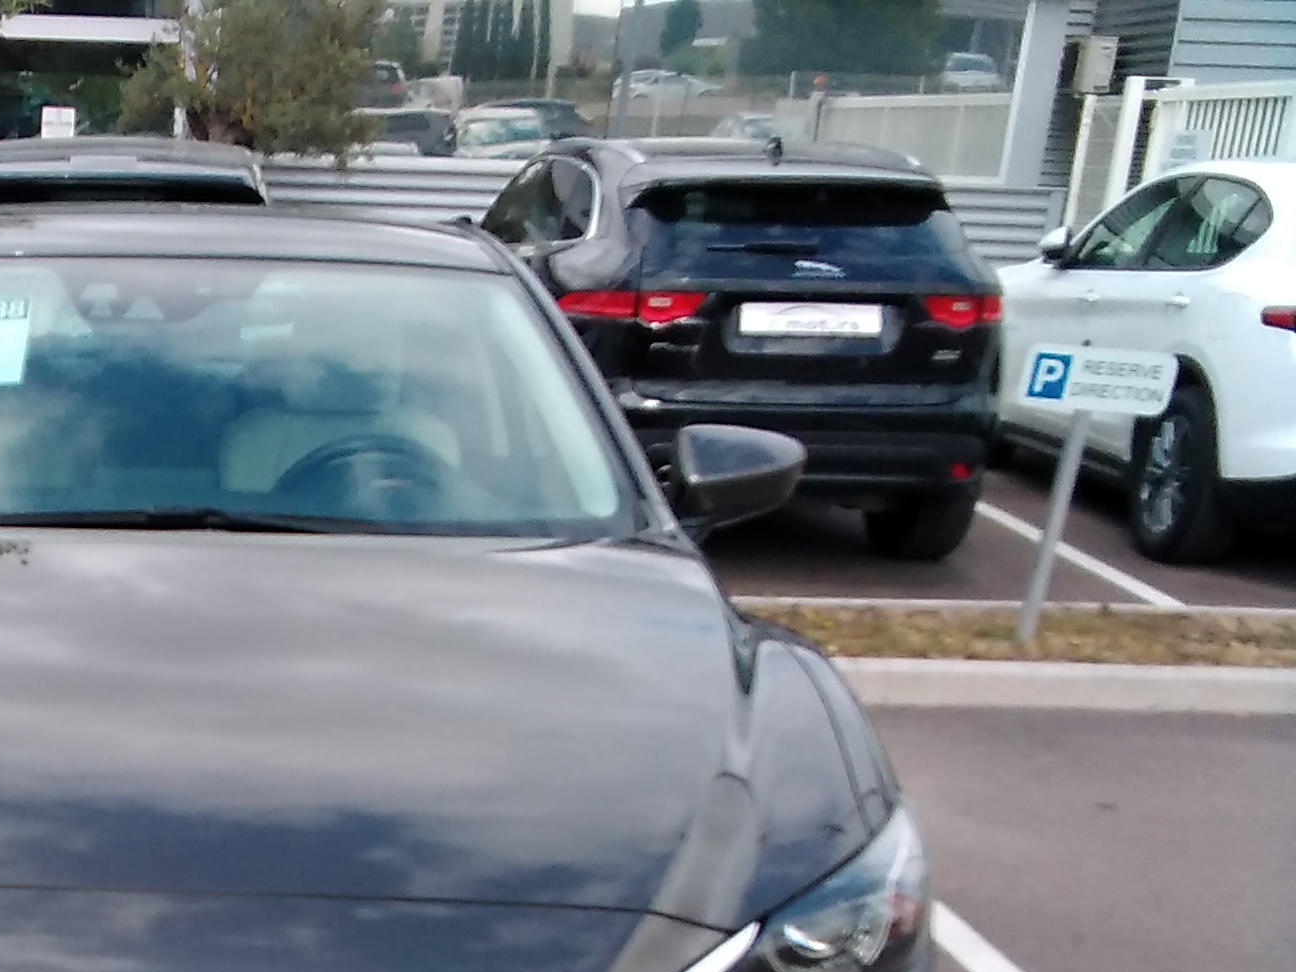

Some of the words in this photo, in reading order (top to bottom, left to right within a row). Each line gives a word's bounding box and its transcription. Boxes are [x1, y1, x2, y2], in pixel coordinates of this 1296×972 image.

[1033, 358, 1066, 394] P
[1081, 360, 1164, 380] RESERVE
[1068, 381, 1163, 402] DIRECTION
